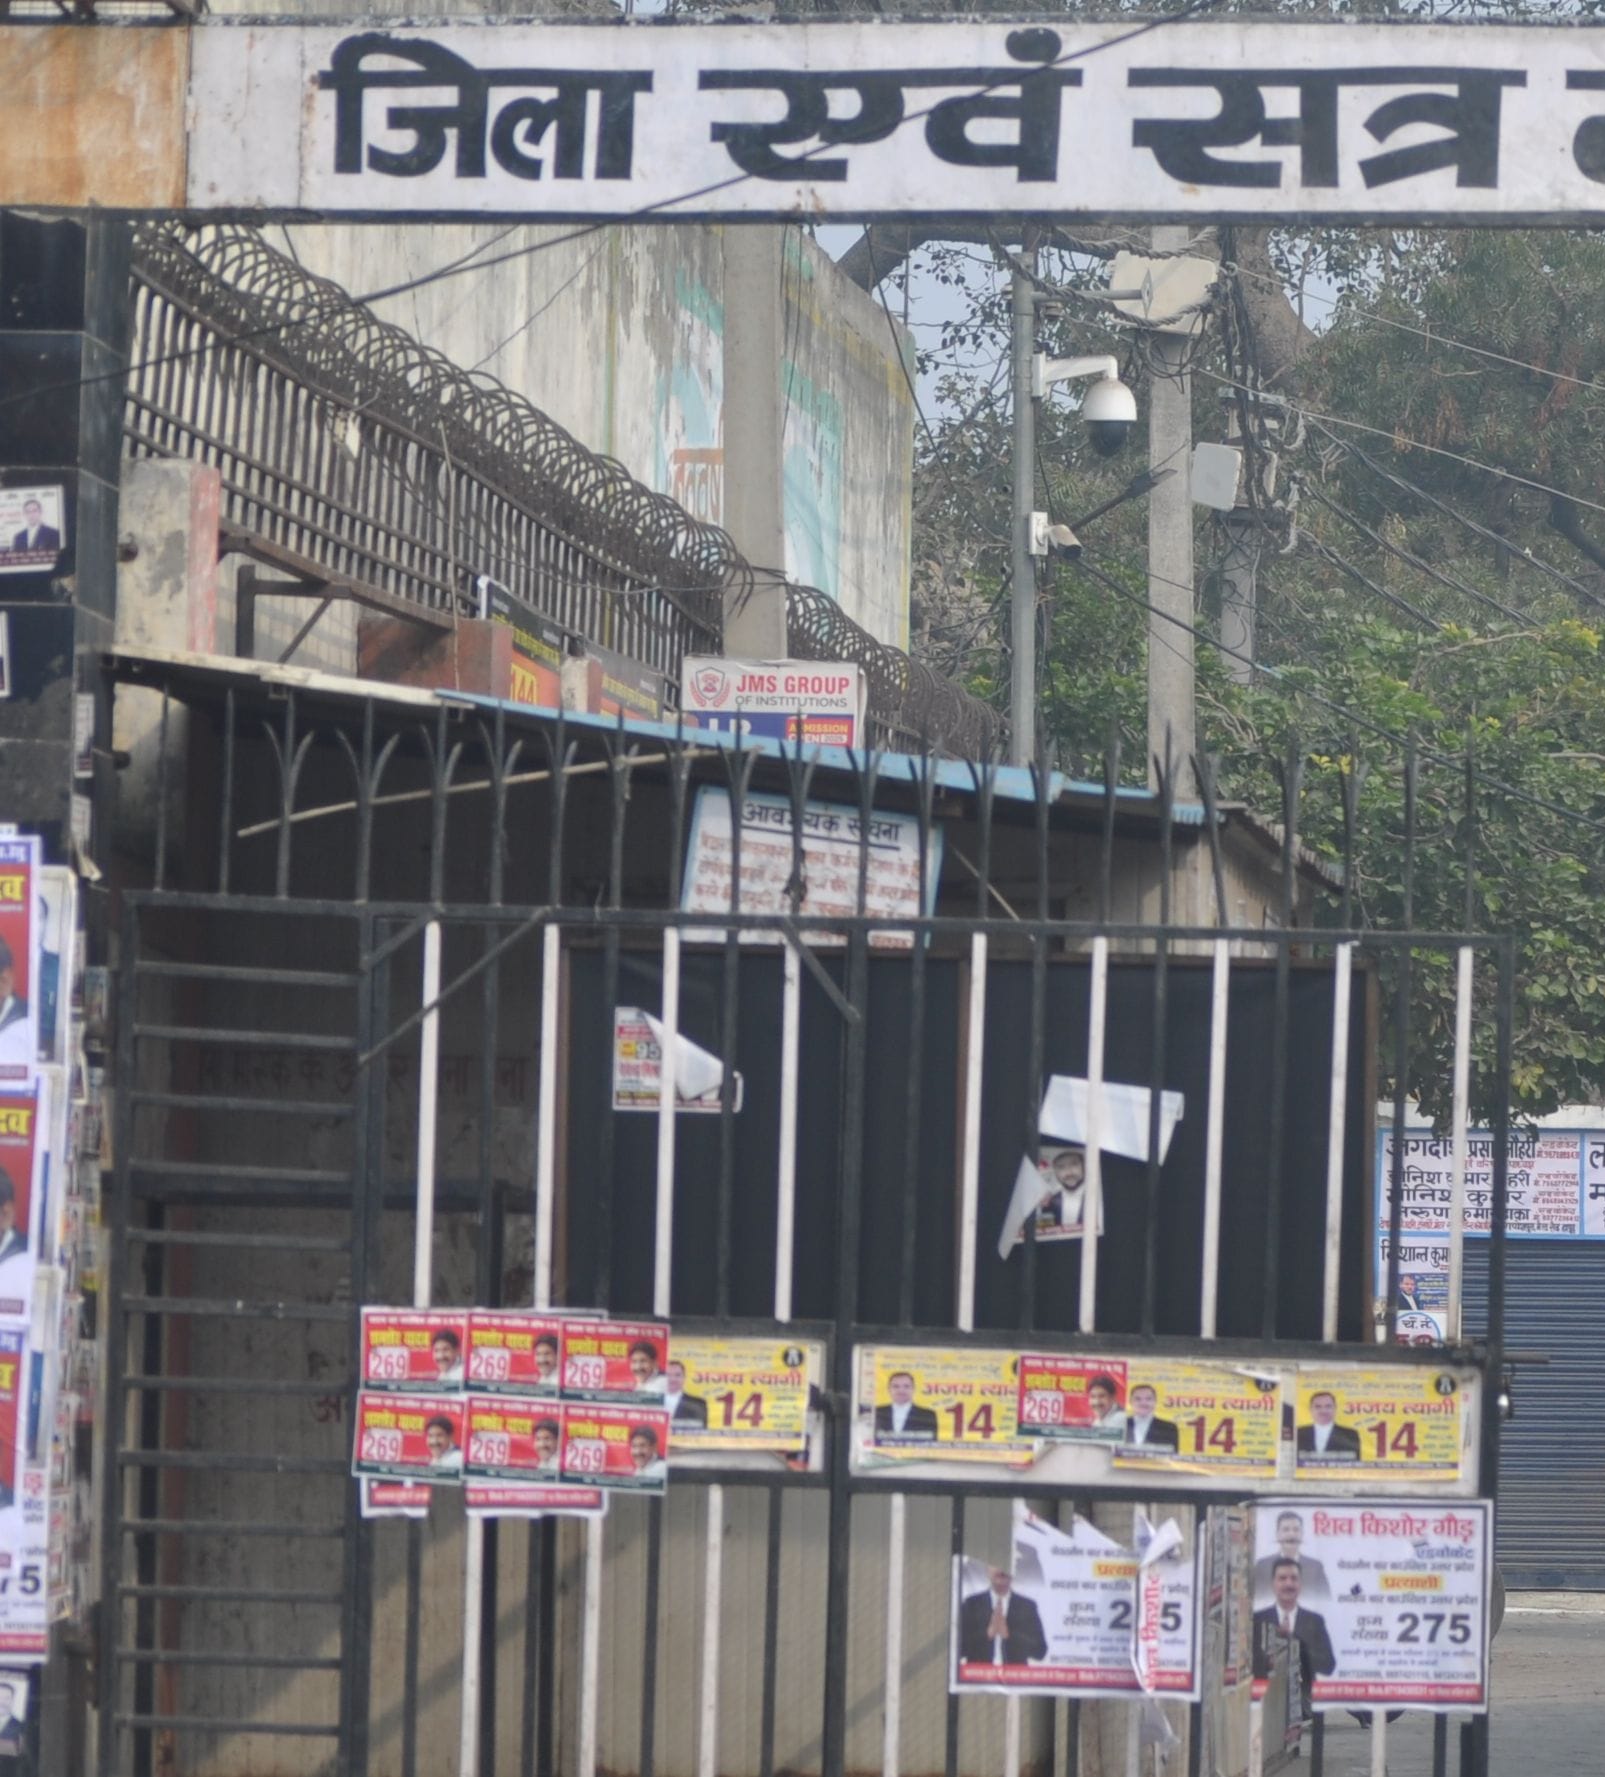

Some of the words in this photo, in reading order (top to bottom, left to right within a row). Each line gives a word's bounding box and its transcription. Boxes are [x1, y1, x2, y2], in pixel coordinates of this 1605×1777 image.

[319, 33, 654, 181] जिला
[698, 28, 1083, 183] एवं
[1128, 67, 1528, 190] सत्र
[736, 675, 777, 693] JMS
[784, 676, 850, 695] GROUP
[735, 695, 752, 706] OF
[755, 696, 848, 707] INSTITUTIONS
[1430, 1246, 1450, 1268] कुम
[371, 1354, 405, 1379] 269
[471, 1354, 507, 1380] 269
[568, 1363, 601, 1389] 269
[922, 1382, 973, 1396] अजय
[715, 1391, 763, 1427] 14
[1025, 1393, 1062, 1422] 269
[1163, 1394, 1216, 1411] अजय
[1222, 1393, 1275, 1412] त्यागी
[1343, 1399, 1396, 1416] अजय
[1402, 1396, 1455, 1416] त्यागी
[945, 1402, 995, 1438] 14
[1187, 1415, 1237, 1454] 14
[1368, 1421, 1418, 1459] 14
[365, 1436, 398, 1461] 269
[471, 1438, 507, 1464] 269
[568, 1447, 601, 1472] 269
[1313, 1511, 1353, 1536] शिव
[1360, 1510, 1427, 1537] किशोर
[1433, 1512, 1475, 1543] गौड़
[1384, 1575, 1439, 1590] प्रत्याशी
[1397, 1613, 1471, 1644] 275
